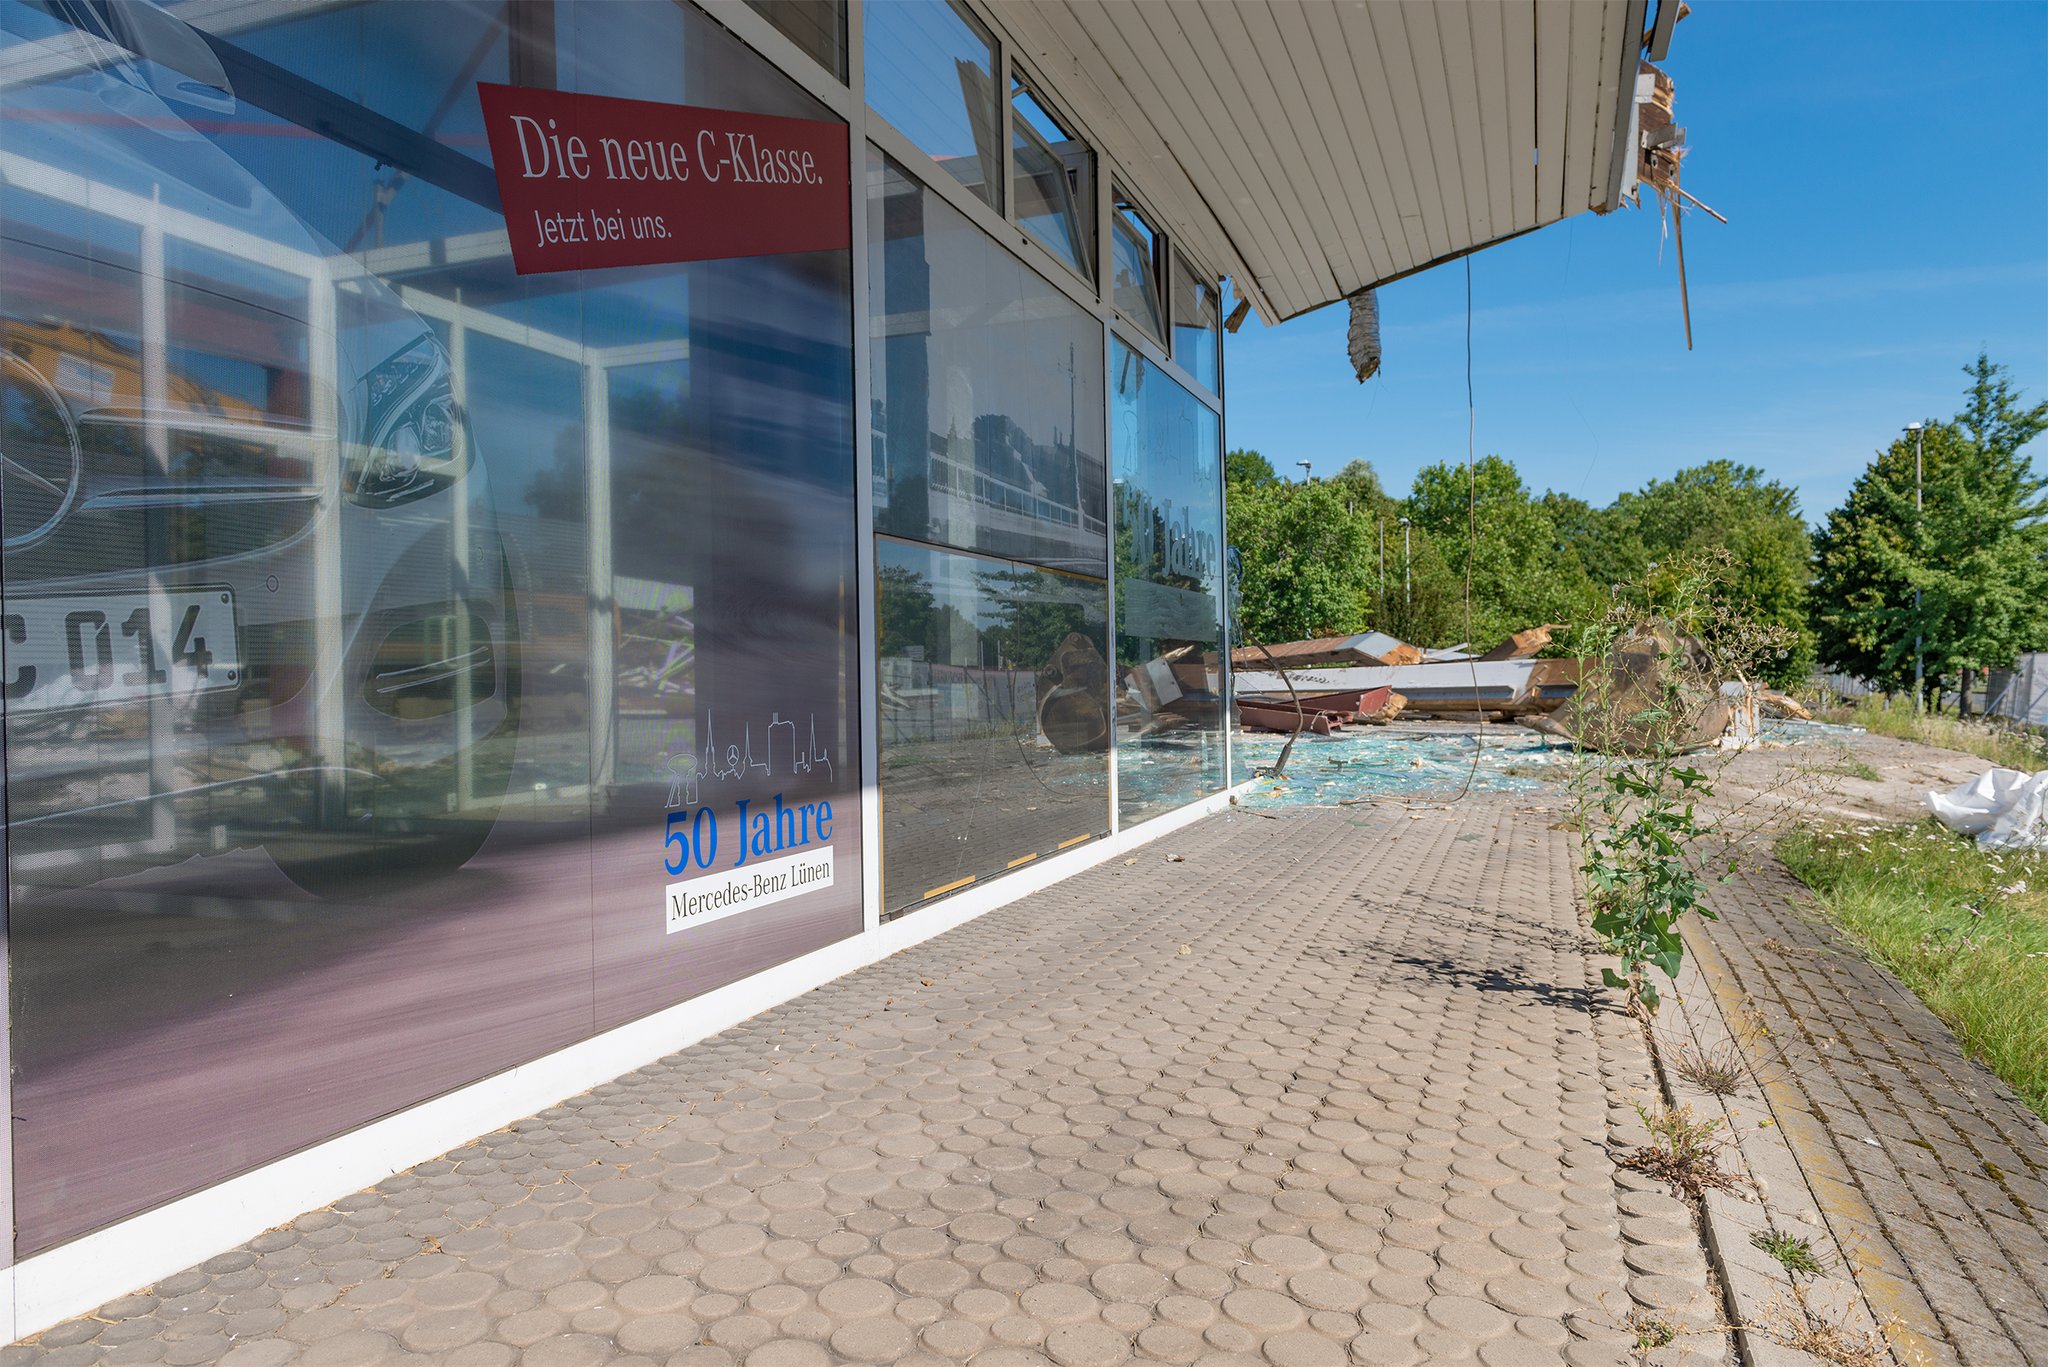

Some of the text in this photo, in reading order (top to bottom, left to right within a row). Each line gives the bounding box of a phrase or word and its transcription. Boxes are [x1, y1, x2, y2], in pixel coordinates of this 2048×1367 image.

[510, 115, 824, 185] Die neue C-Klasse.
[534, 208, 672, 248] Jetzt bei uns.
[1162, 498, 1216, 580] Jahre
[65, 604, 213, 691] 014
[665, 792, 833, 876] 50 Jahre
[671, 862, 830, 920] Mercedes-Benz Lünen
